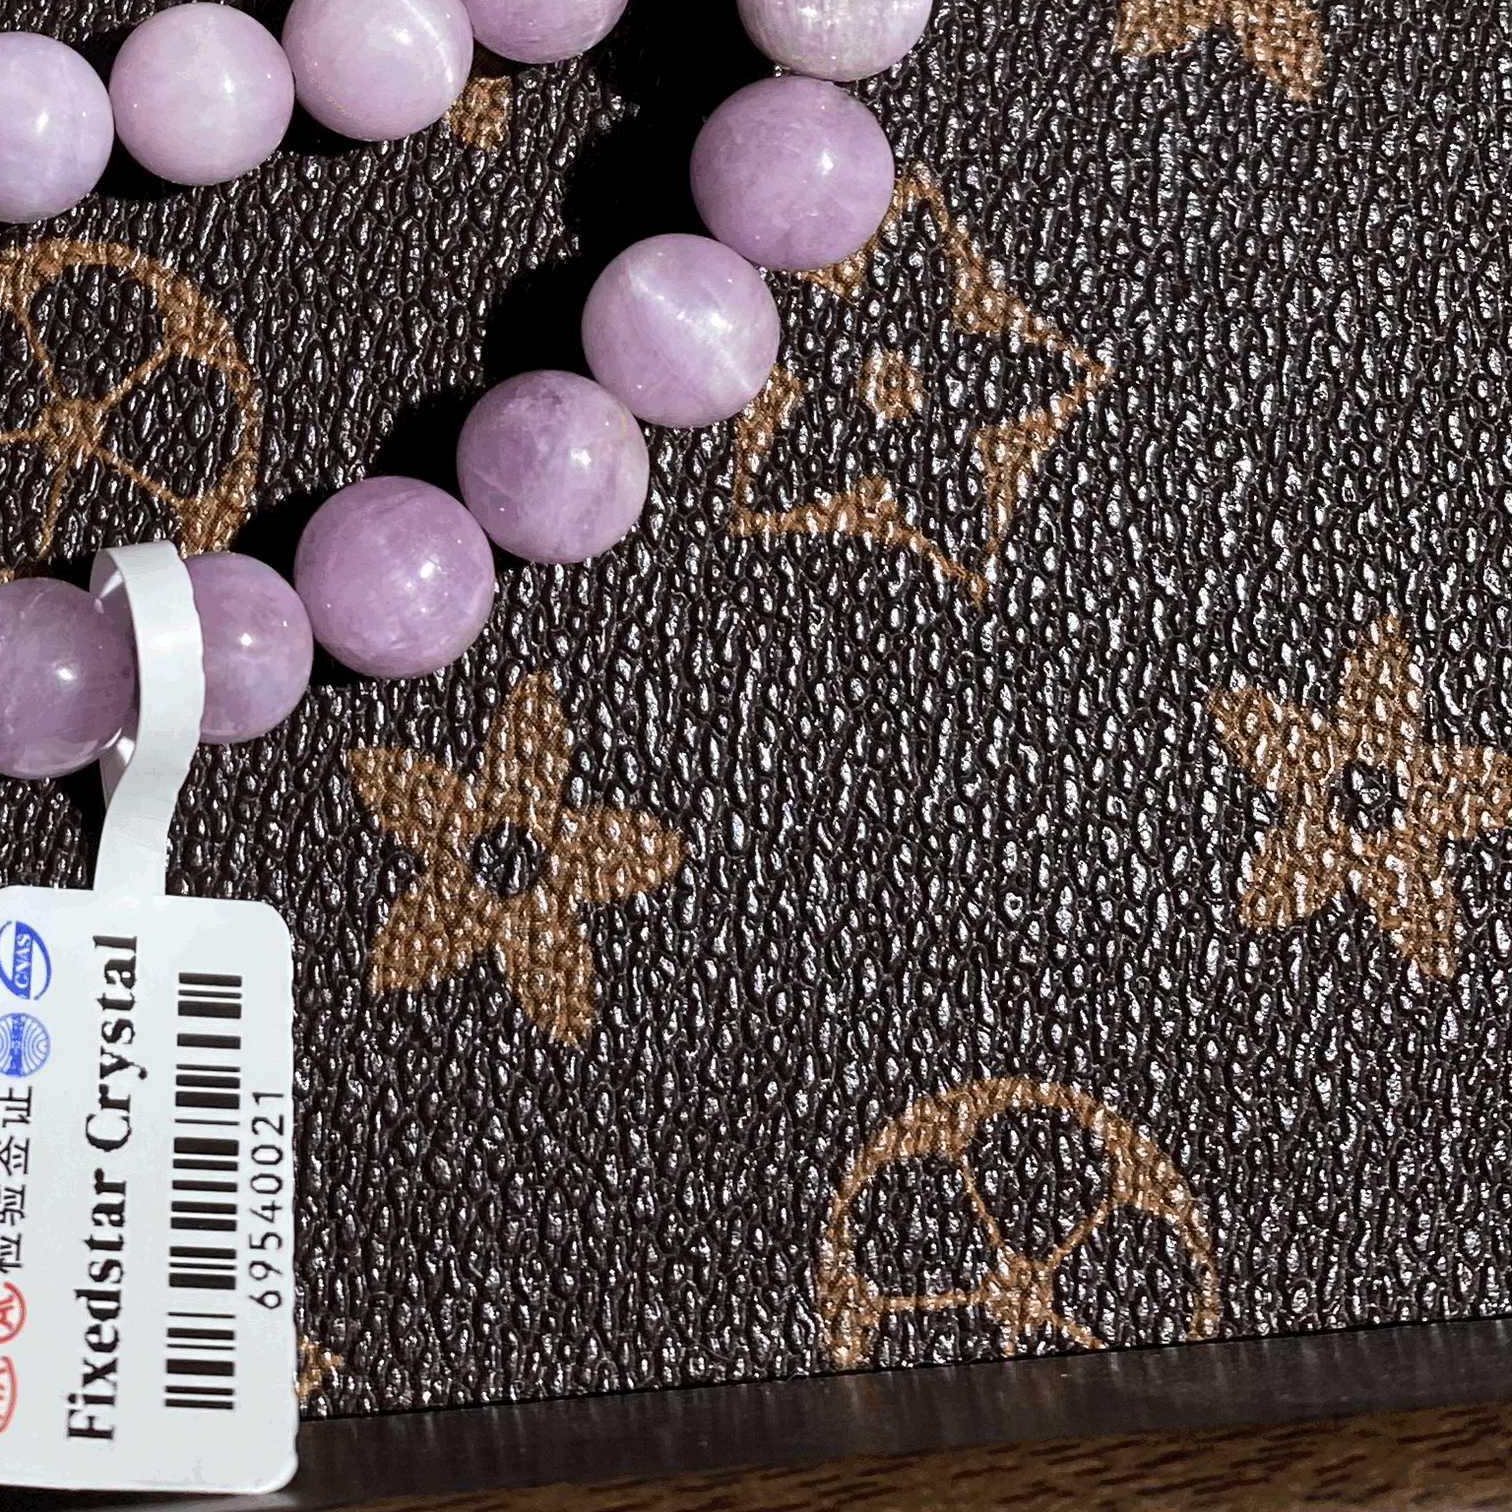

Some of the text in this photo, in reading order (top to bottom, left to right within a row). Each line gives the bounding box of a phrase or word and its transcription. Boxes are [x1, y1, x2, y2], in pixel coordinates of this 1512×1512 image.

[67, 934, 148, 1440] Fixedstar Crystal
[247, 1090, 285, 1311] 69540021
